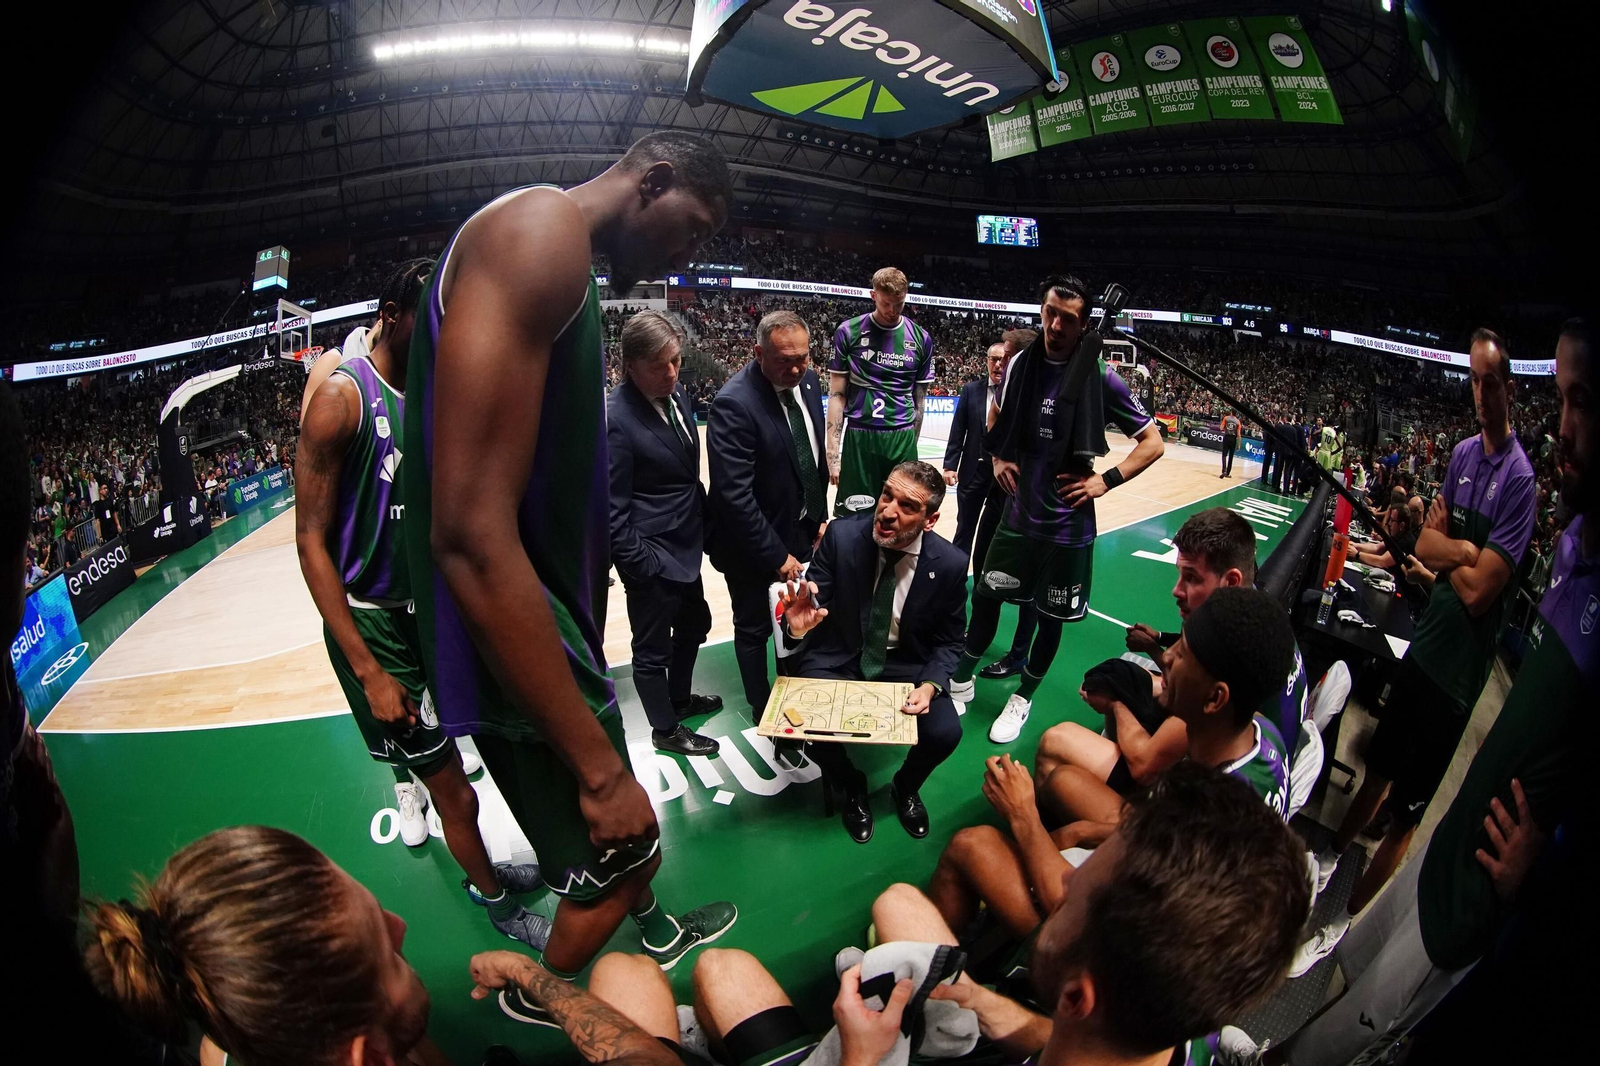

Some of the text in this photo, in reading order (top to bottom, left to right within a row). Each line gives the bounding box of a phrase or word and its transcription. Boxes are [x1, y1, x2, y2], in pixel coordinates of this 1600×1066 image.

[783, 0, 1000, 106] Unicaja
[1151, 59, 1178, 67] EuroCup
[1145, 79, 1200, 96] CAMPEONES
[1205, 75, 1263, 89] CAMPEONES
[1270, 76, 1328, 89] CAMPEONES
[1089, 87, 1140, 106] CAMPEONES
[1152, 91, 1198, 105] EUROCUP
[1106, 101, 1129, 113] ACB
[1161, 103, 1195, 113] 2016/2017
[1231, 99, 1250, 107] 2023
[1298, 101, 1318, 110] 2024
[1037, 99, 1084, 120] CAMPEONES
[1038, 118, 1056, 127] COPA
[1072, 110, 1086, 118] REY
[1101, 110, 1137, 122] 2005/2006
[990, 115, 1031, 135] CAMPEONES
[1056, 123, 1072, 133] 2005
[259, 250, 273, 261] 4.6
[669, 276, 679, 286] 96
[698, 277, 718, 286] BARÇA
[781, 282, 791, 290] QUE
[792, 283, 813, 291] BUSCAS
[813, 284, 830, 292] SOBRE
[831, 286, 863, 296] BALONCESTO
[367, 302, 379, 310] TOD
[975, 302, 1007, 310] BALONCESTO
[1192, 315, 1213, 323] UNICAJA
[1222, 317, 1232, 326] 103
[1244, 320, 1255, 328] 4.6
[1280, 323, 1288, 333] 96
[1303, 327, 1320, 336] BARÇA
[214, 335, 225, 345] QUE
[226, 331, 248, 341] BUSCAS
[249, 327, 267, 337] SBRE
[877, 351, 914, 362] Fundación
[1374, 340, 1385, 349] QUE
[1385, 342, 1404, 353] BUSCAS
[1404, 347, 1420, 356] SOBRE
[1420, 350, 1452, 362] BALONCESTO
[35, 353, 137, 375] TODO LO QUE BUSCAS SOBRE BALONCESTO
[244, 360, 275, 374] endesa
[876, 357, 904, 367] Unicaja
[872, 398, 886, 419] 2
[1191, 429, 1224, 443] endesa
[241, 481, 260, 495] Fundación
[243, 490, 259, 502] Unicaja
[68, 544, 127, 596] endesa
